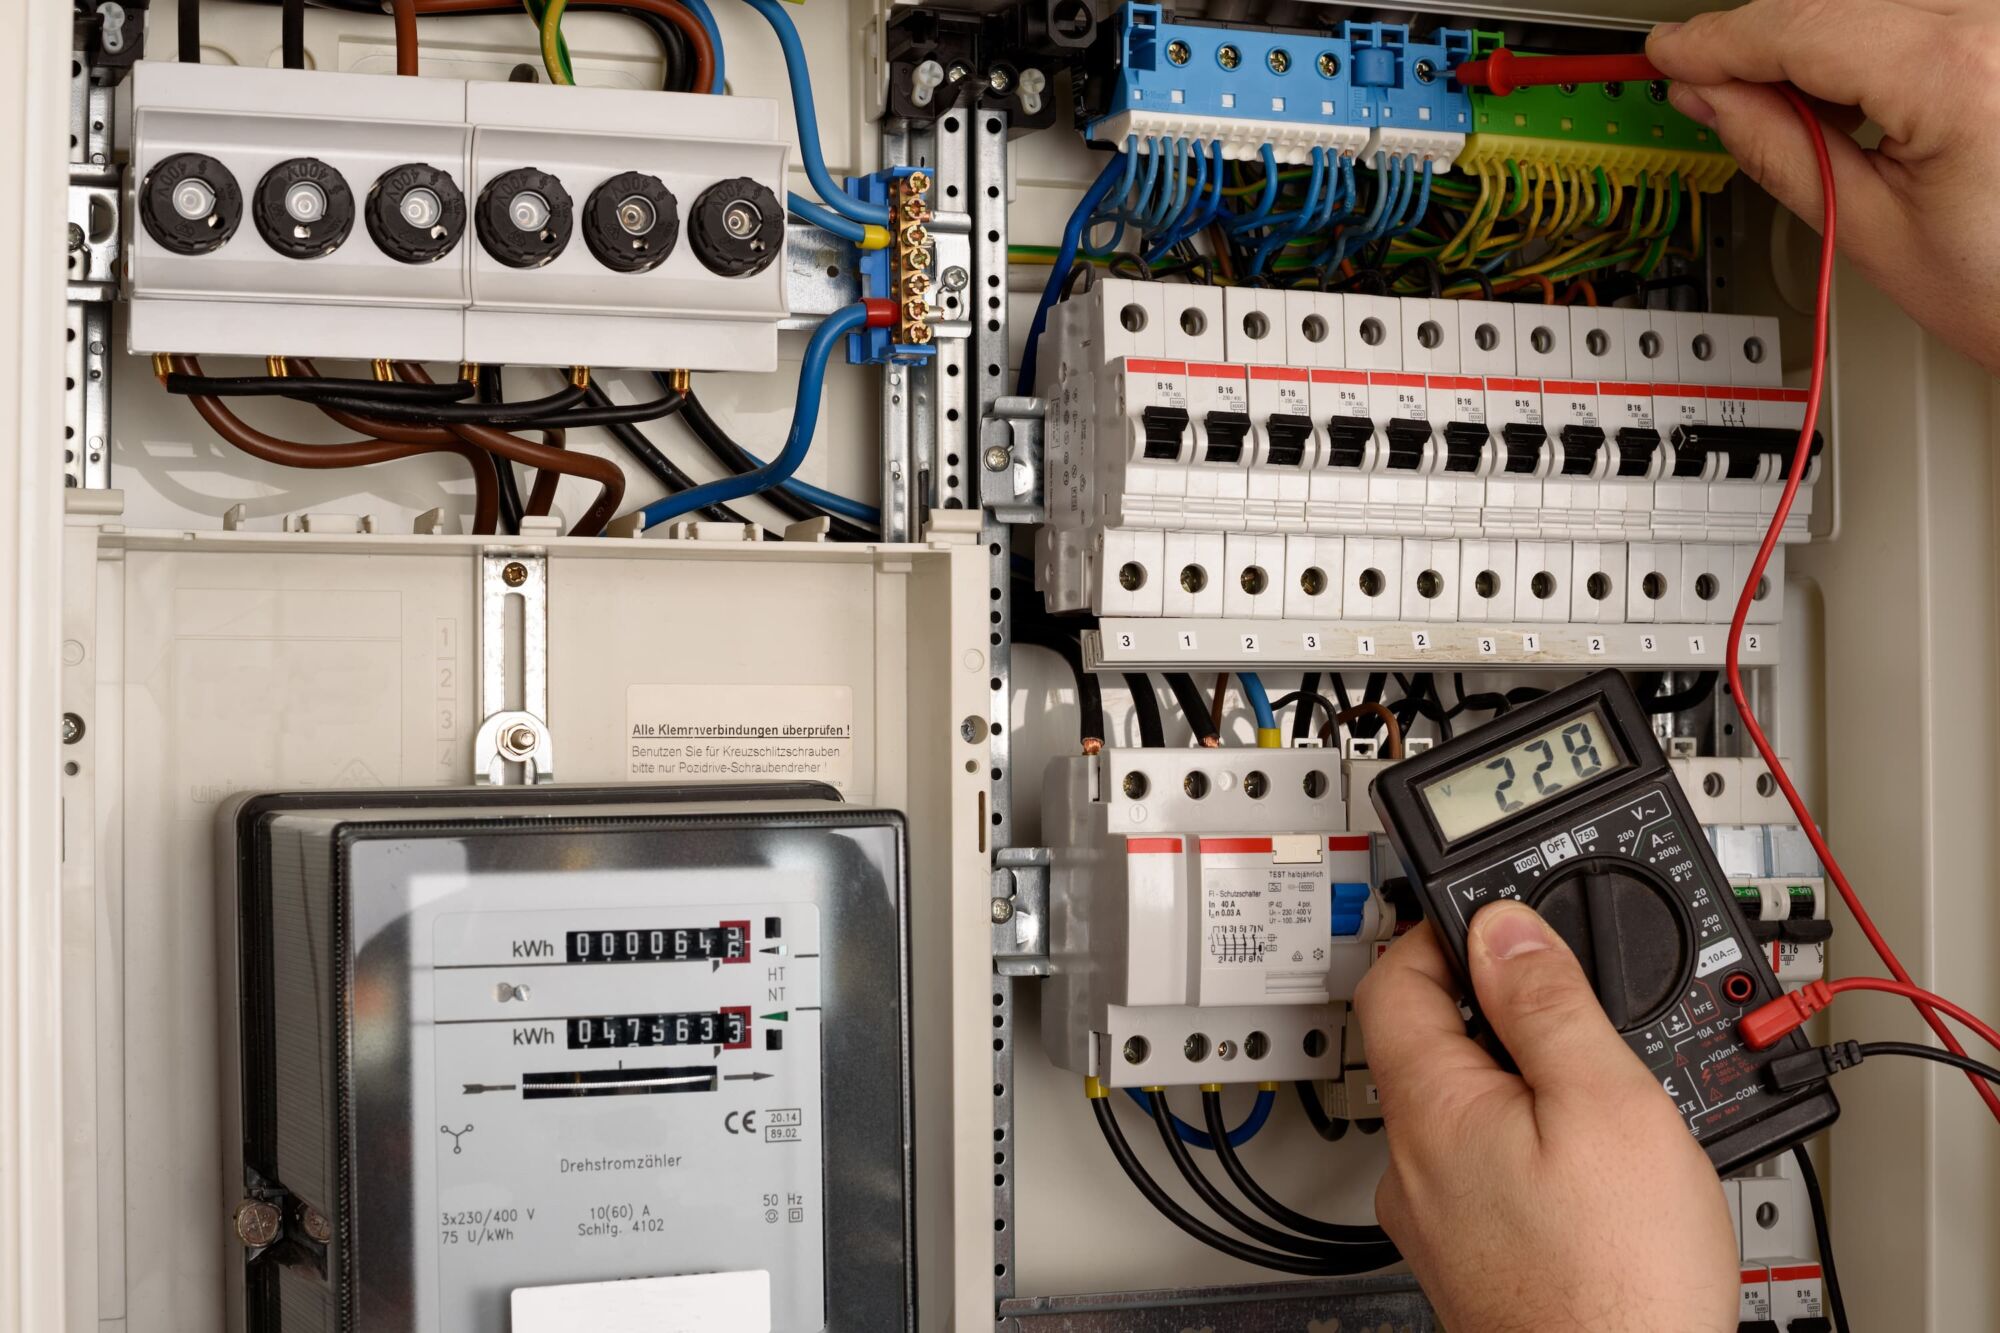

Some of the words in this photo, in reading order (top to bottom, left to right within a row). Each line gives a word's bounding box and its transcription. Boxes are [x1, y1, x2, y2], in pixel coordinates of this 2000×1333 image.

[1225, 386, 1233, 394] 16
[1288, 389, 1296, 397] 16
[1348, 392, 1355, 400] 16
[442, 627, 448, 647] 1
[1122, 635, 1130, 647] 3
[1184, 635, 1191, 647] 1
[1245, 638, 1254, 649] 2
[1307, 636, 1316, 648] 3
[1417, 634, 1425, 646] 2
[1528, 637, 1533, 649] 1
[1645, 638, 1652, 649] 3
[1750, 637, 1757, 648] 2
[1363, 640, 1369, 651] 1
[1482, 640, 1491, 652] 3
[1592, 639, 1600, 650] 2
[1694, 640, 1699, 651] 1
[440, 668, 452, 688] 2
[441, 710, 453, 729] 3
[633, 724, 655, 736] Alle
[782, 723, 843, 738] überprüfen
[440, 748, 452, 767] 4
[632, 745, 682, 757] Benutzen
[685, 745, 703, 757] Sie
[706, 745, 719, 757] für
[723, 745, 840, 757] Kreuzschlitzschrauben
[632, 762, 655, 773] bitte
[658, 764, 675, 773] nur
[679, 761, 821, 773] Pozidrive-Schraubendreher
[1441, 784, 1451, 797] V
[1486, 722, 1601, 812] 228
[1577, 829, 1596, 843] 750
[1617, 829, 1635, 843] 200
[1546, 838, 1567, 854] OFF
[1657, 844, 1681, 861] 200µ
[1515, 855, 1539, 871] 1000
[1669, 860, 1693, 876] 2000
[1220, 890, 1261, 898] Schutzschalter
[1499, 884, 1516, 898] 200
[1694, 887, 1707, 899] 20
[1700, 896, 1710, 906] m
[1221, 909, 1235, 917] 0.03
[1236, 909, 1241, 917] A
[1702, 914, 1720, 928] 200
[1712, 923, 1722, 932] m
[512, 940, 554, 958] kWh
[1789, 944, 1798, 954] 16
[768, 967, 785, 981] HT
[768, 987, 785, 1001] NT
[1693, 1001, 1714, 1016] hFE
[1696, 1026, 1714, 1040] 10A
[1716, 1018, 1731, 1031] DC
[513, 1028, 554, 1045] kWh
[1646, 1041, 1664, 1054] 200
[1708, 1044, 1739, 1063] VΩmA
[1735, 1084, 1758, 1101] COM
[724, 1110, 757, 1134] CE
[771, 1113, 797, 1123] 20.14
[771, 1128, 797, 1139] 89.02
[560, 1154, 682, 1173] Drehstromzähler
[763, 1194, 779, 1207] 50
[787, 1193, 803, 1205] Hz
[441, 1208, 518, 1226] 3x230/400
[526, 1208, 535, 1220] V
[590, 1204, 634, 1221] 10(60)
[642, 1204, 651, 1217] A
[578, 1222, 622, 1238] Schltg.
[632, 1219, 664, 1233] 4102
[442, 1231, 458, 1245] 75
[468, 1228, 514, 1246] U/kWh
